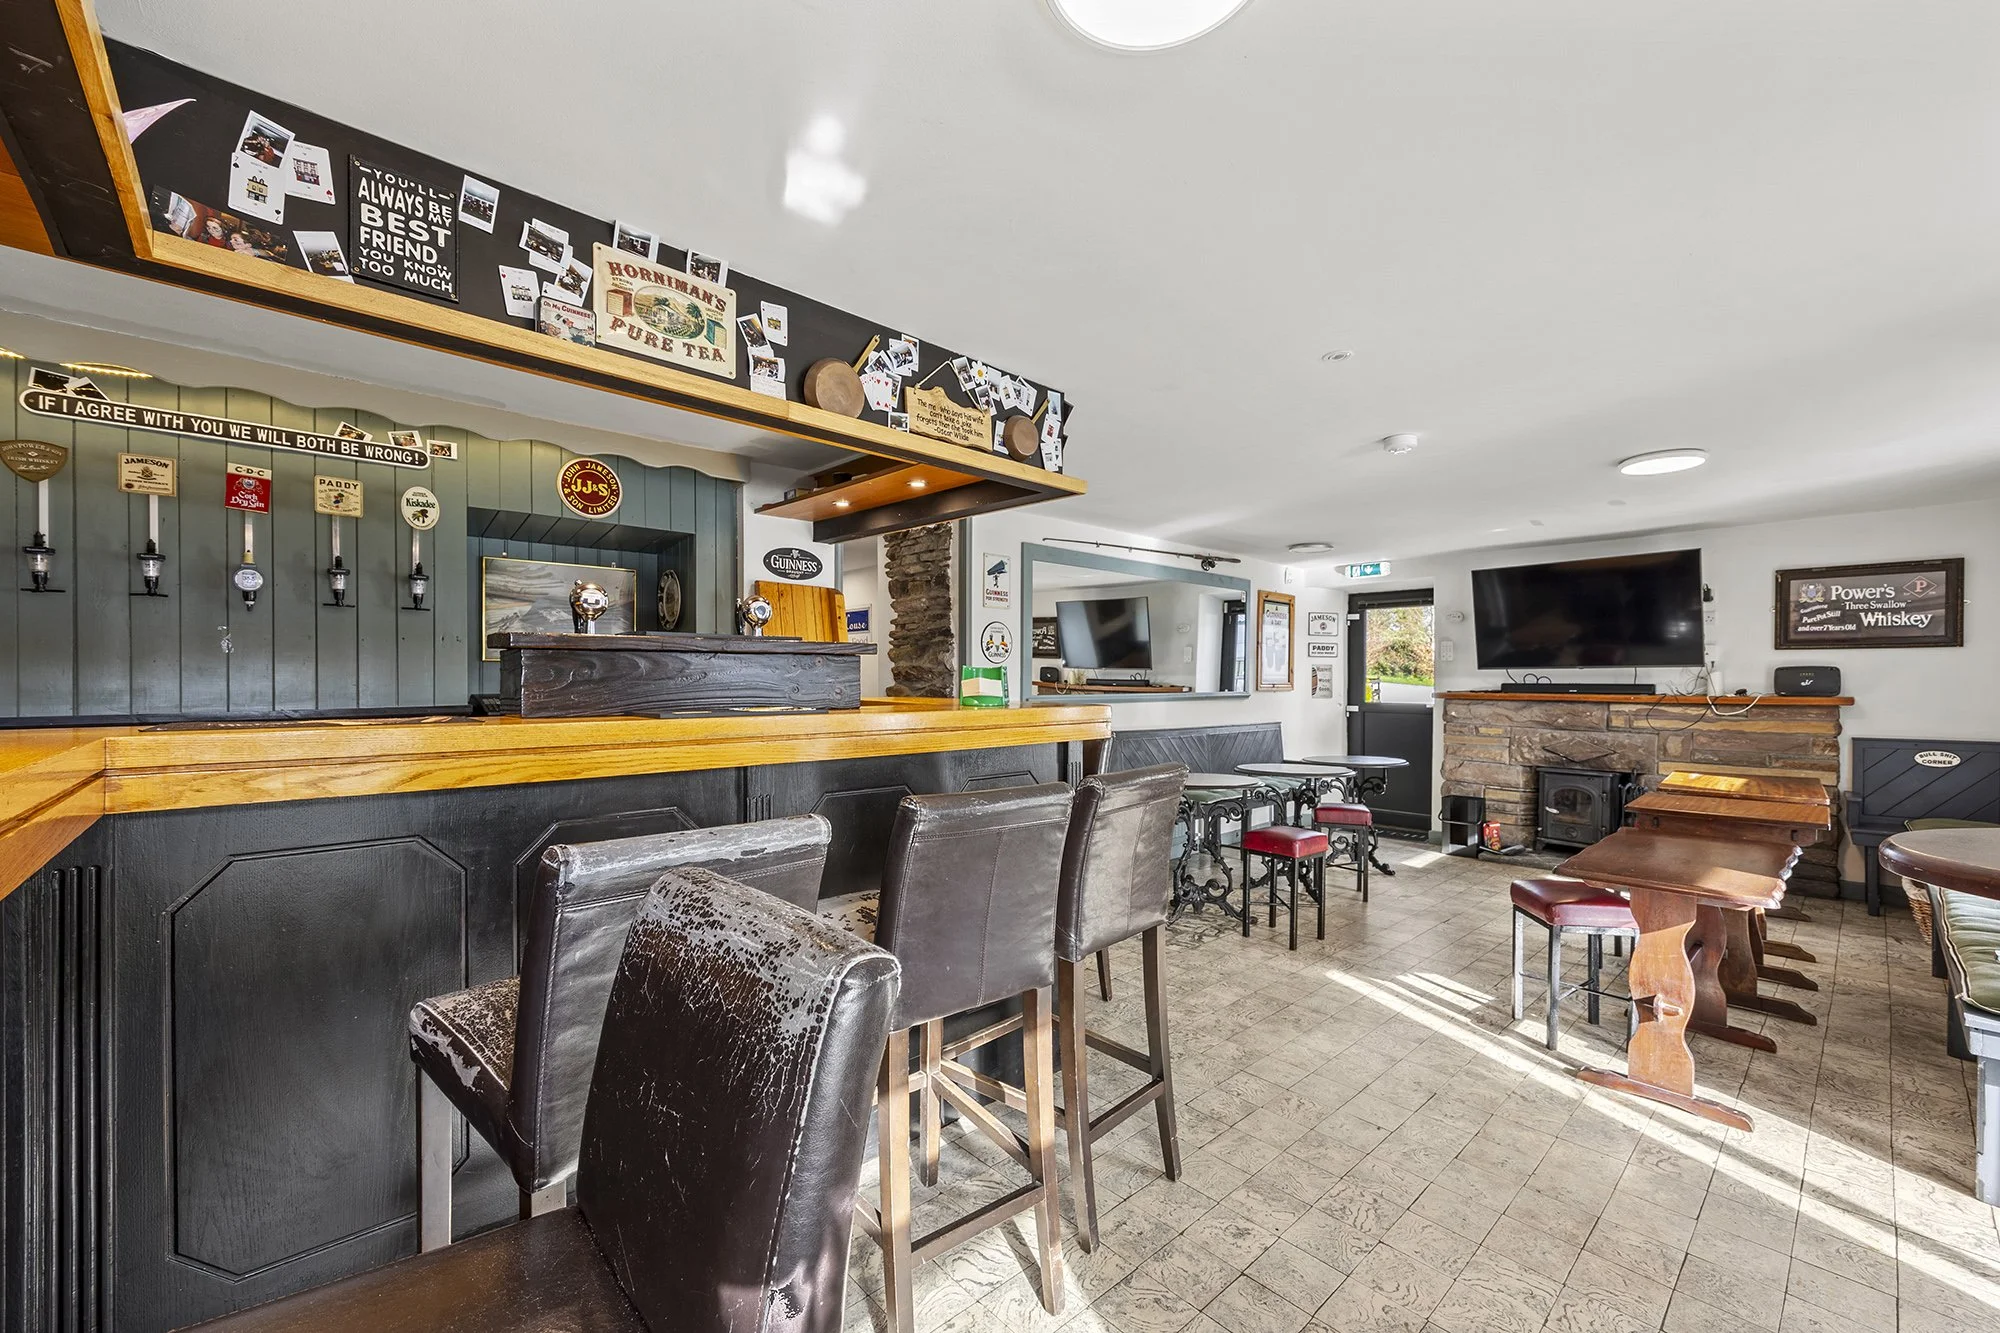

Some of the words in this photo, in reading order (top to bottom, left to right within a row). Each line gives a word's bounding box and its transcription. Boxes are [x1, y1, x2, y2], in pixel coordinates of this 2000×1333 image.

[358, 176, 424, 218] ALWAYS
[428, 200, 452, 218] BE
[360, 202, 452, 247] BEST
[428, 212, 452, 228] MY
[360, 246, 394, 263] YOU
[359, 256, 395, 276] TOO
[403, 259, 452, 280] KNOW
[404, 270, 453, 293] MUCH
[606, 261, 727, 313] HORNIMAN'S
[609, 316, 674, 353] PURE
[682, 342, 726, 362] TEA
[917, 398, 927, 408] The
[38, 395, 56, 410] IF
[62, 399, 68, 412] I
[74, 401, 136, 423] AGREE
[143, 411, 184, 430] WITH
[191, 418, 223, 436] YOU
[229, 423, 252, 440] WE
[257, 428, 291, 446] WILL
[296, 435, 336, 453] BOTH
[341, 441, 359, 456] BE
[365, 445, 420, 465] WRONG!
[124, 458, 170, 469] JAMESON
[319, 478, 359, 490] PADDY
[563, 463, 581, 483] JOHN
[585, 462, 618, 490] JAMESON
[571, 478, 609, 497] JJ&S
[230, 496, 248, 507] Dry
[406, 497, 436, 509] Kiskadee
[567, 495, 584, 509] SON
[588, 495, 618, 514] LIMITED
[771, 554, 818, 572] GUINNESS
[985, 588, 1009, 597] GUINNESS
[1830, 583, 1896, 601] Power's
[1310, 614, 1336, 623] JAMESON
[1802, 615, 1817, 624] Pure
[1826, 609, 1841, 618] Still
[1859, 610, 1933, 628] Whiskey
[1844, 623, 1857, 631] Old
